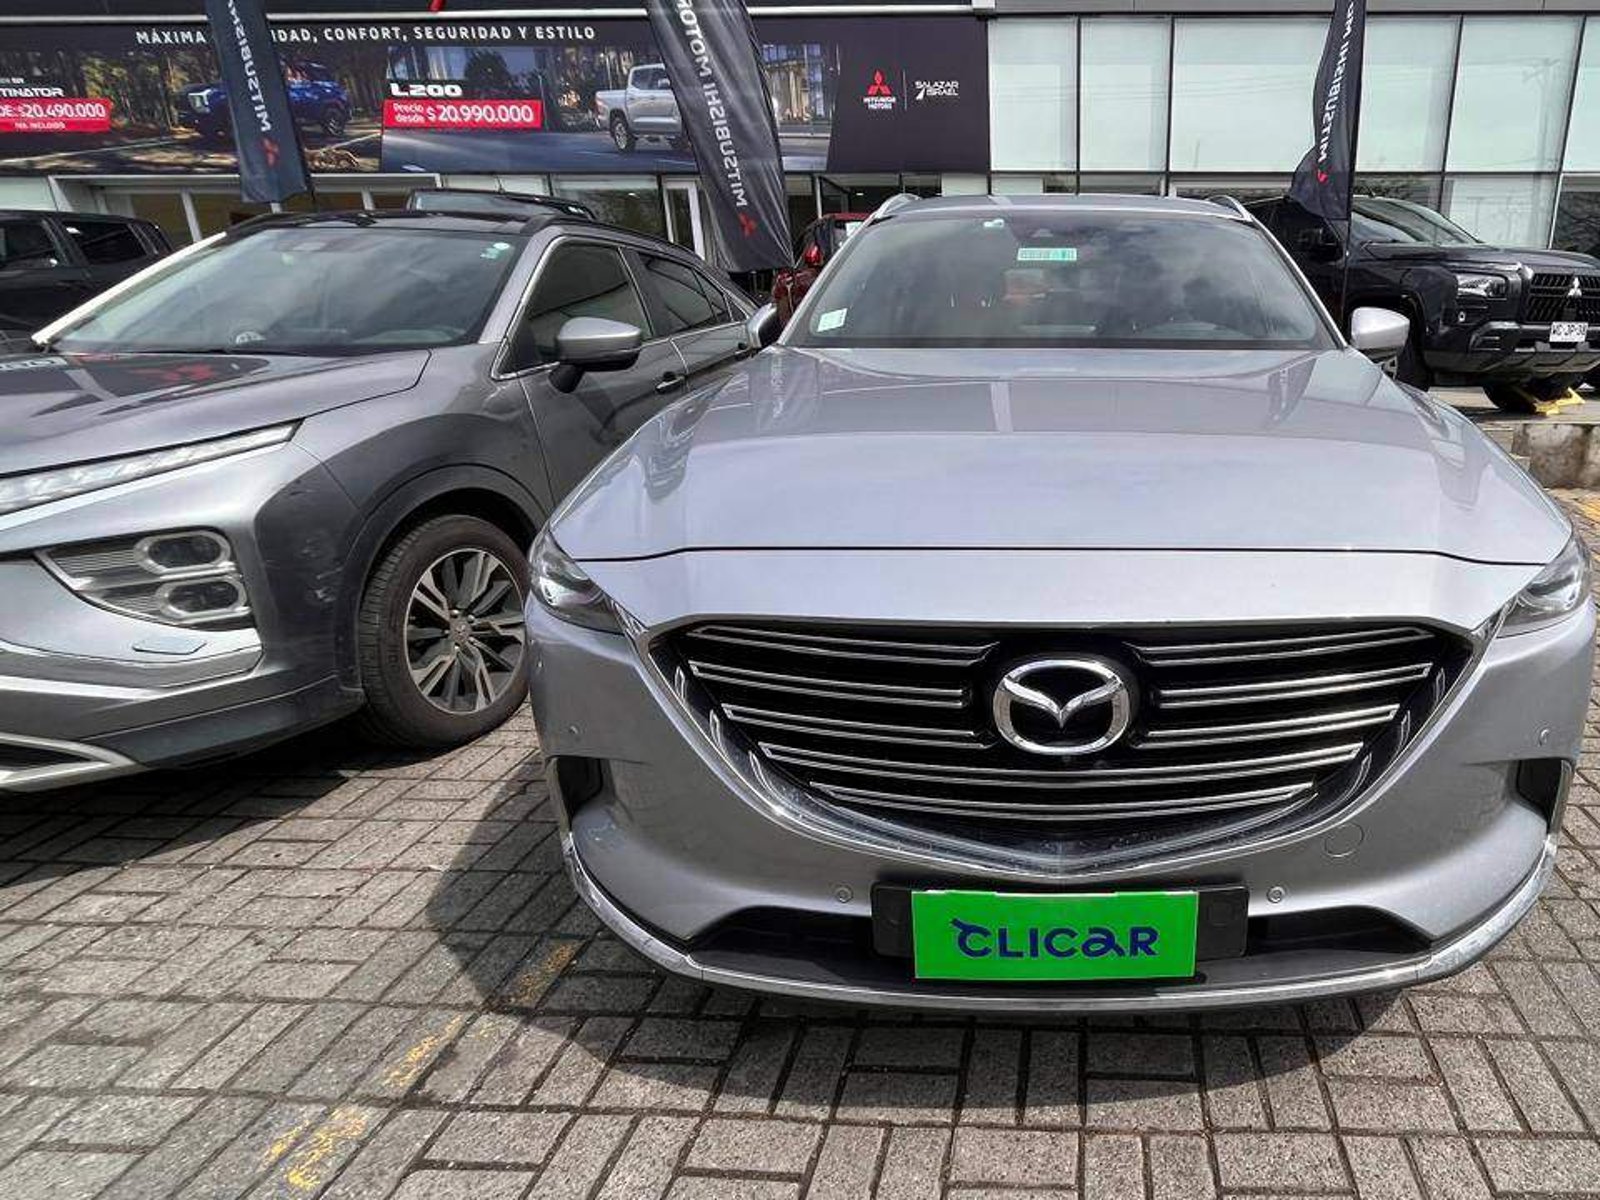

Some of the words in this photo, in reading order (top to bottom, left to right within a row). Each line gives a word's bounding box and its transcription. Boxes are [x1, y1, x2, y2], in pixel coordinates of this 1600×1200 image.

[135, 28, 207, 44] MÁXIMA
[324, 26, 408, 42] CONFORT,
[413, 26, 511, 40] SEGURIDAD
[517, 26, 529, 39] Y
[535, 26, 595, 39] ESTILO
[390, 83, 463, 97] L200
